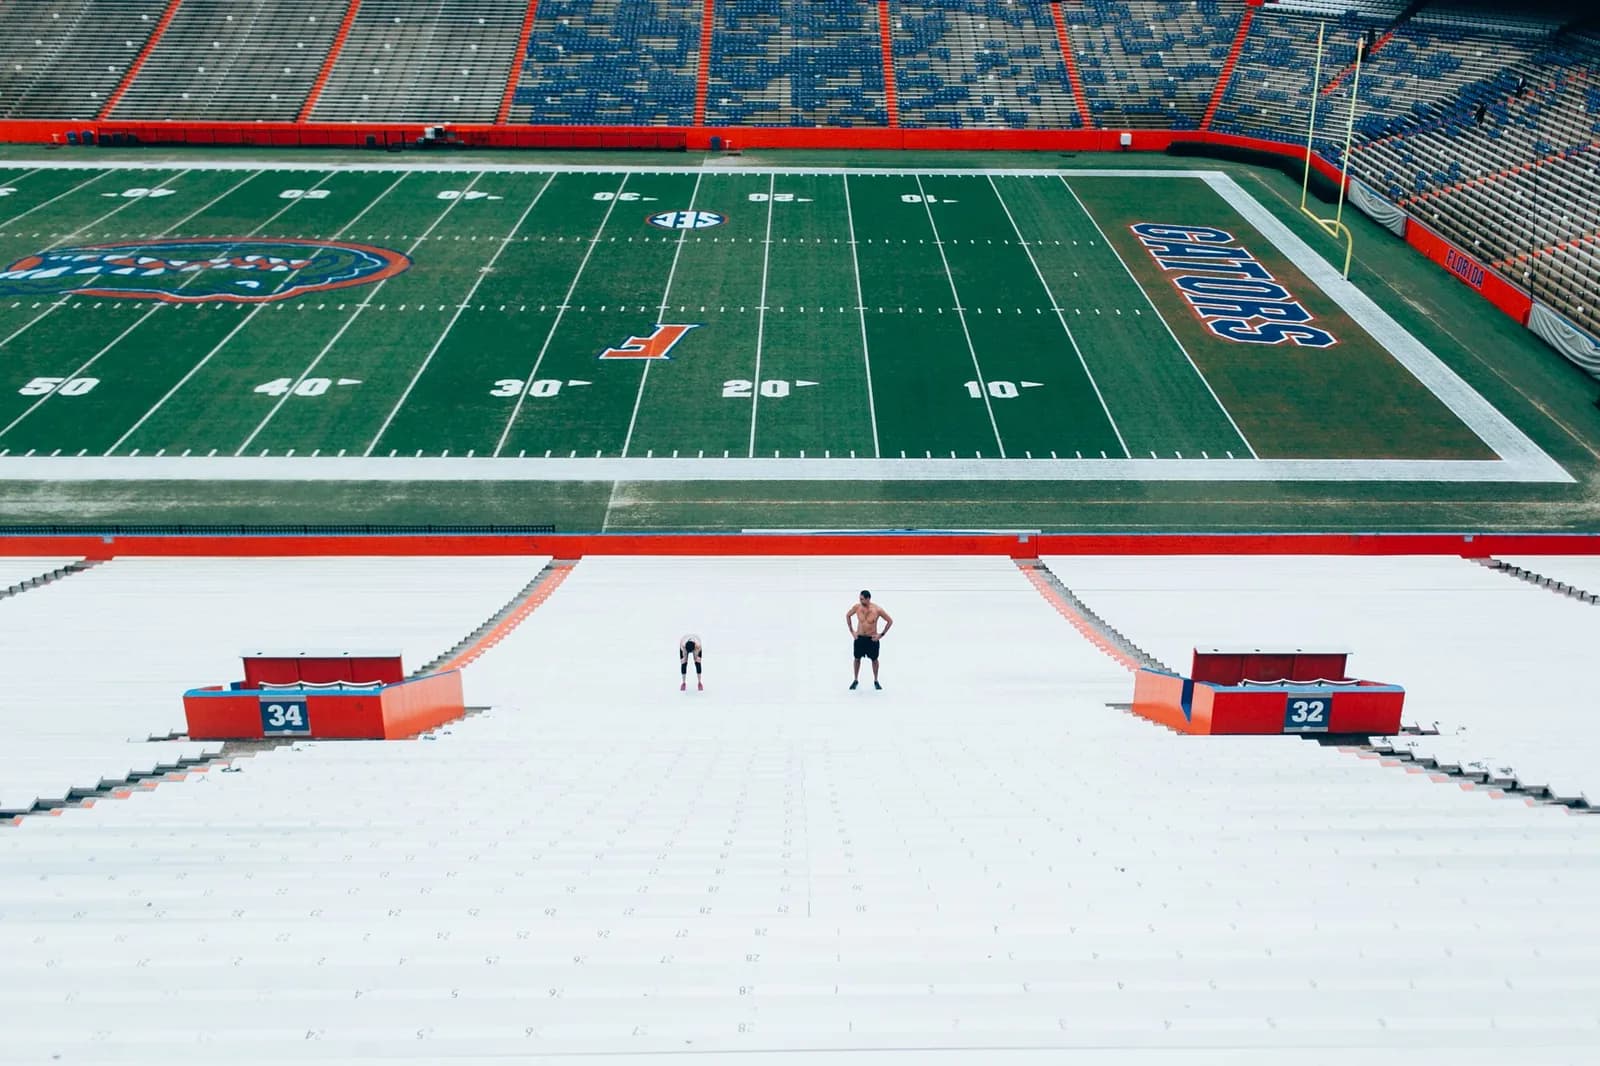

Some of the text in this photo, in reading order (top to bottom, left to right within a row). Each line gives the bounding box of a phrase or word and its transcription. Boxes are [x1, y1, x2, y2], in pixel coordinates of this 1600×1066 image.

[749, 193, 794, 201] 20
[901, 194, 937, 203] 10
[650, 211, 724, 229] SEC
[1446, 248, 1484, 288] FLORIDA
[1131, 223, 1338, 348] GATORS
[598, 324, 702, 359] F
[18, 377, 100, 396] 50
[254, 378, 331, 396] 40
[490, 379, 563, 397] 30
[722, 380, 790, 398] 20
[964, 380, 1019, 399] 10
[267, 704, 303, 727] 34
[1291, 701, 1323, 723] 32
